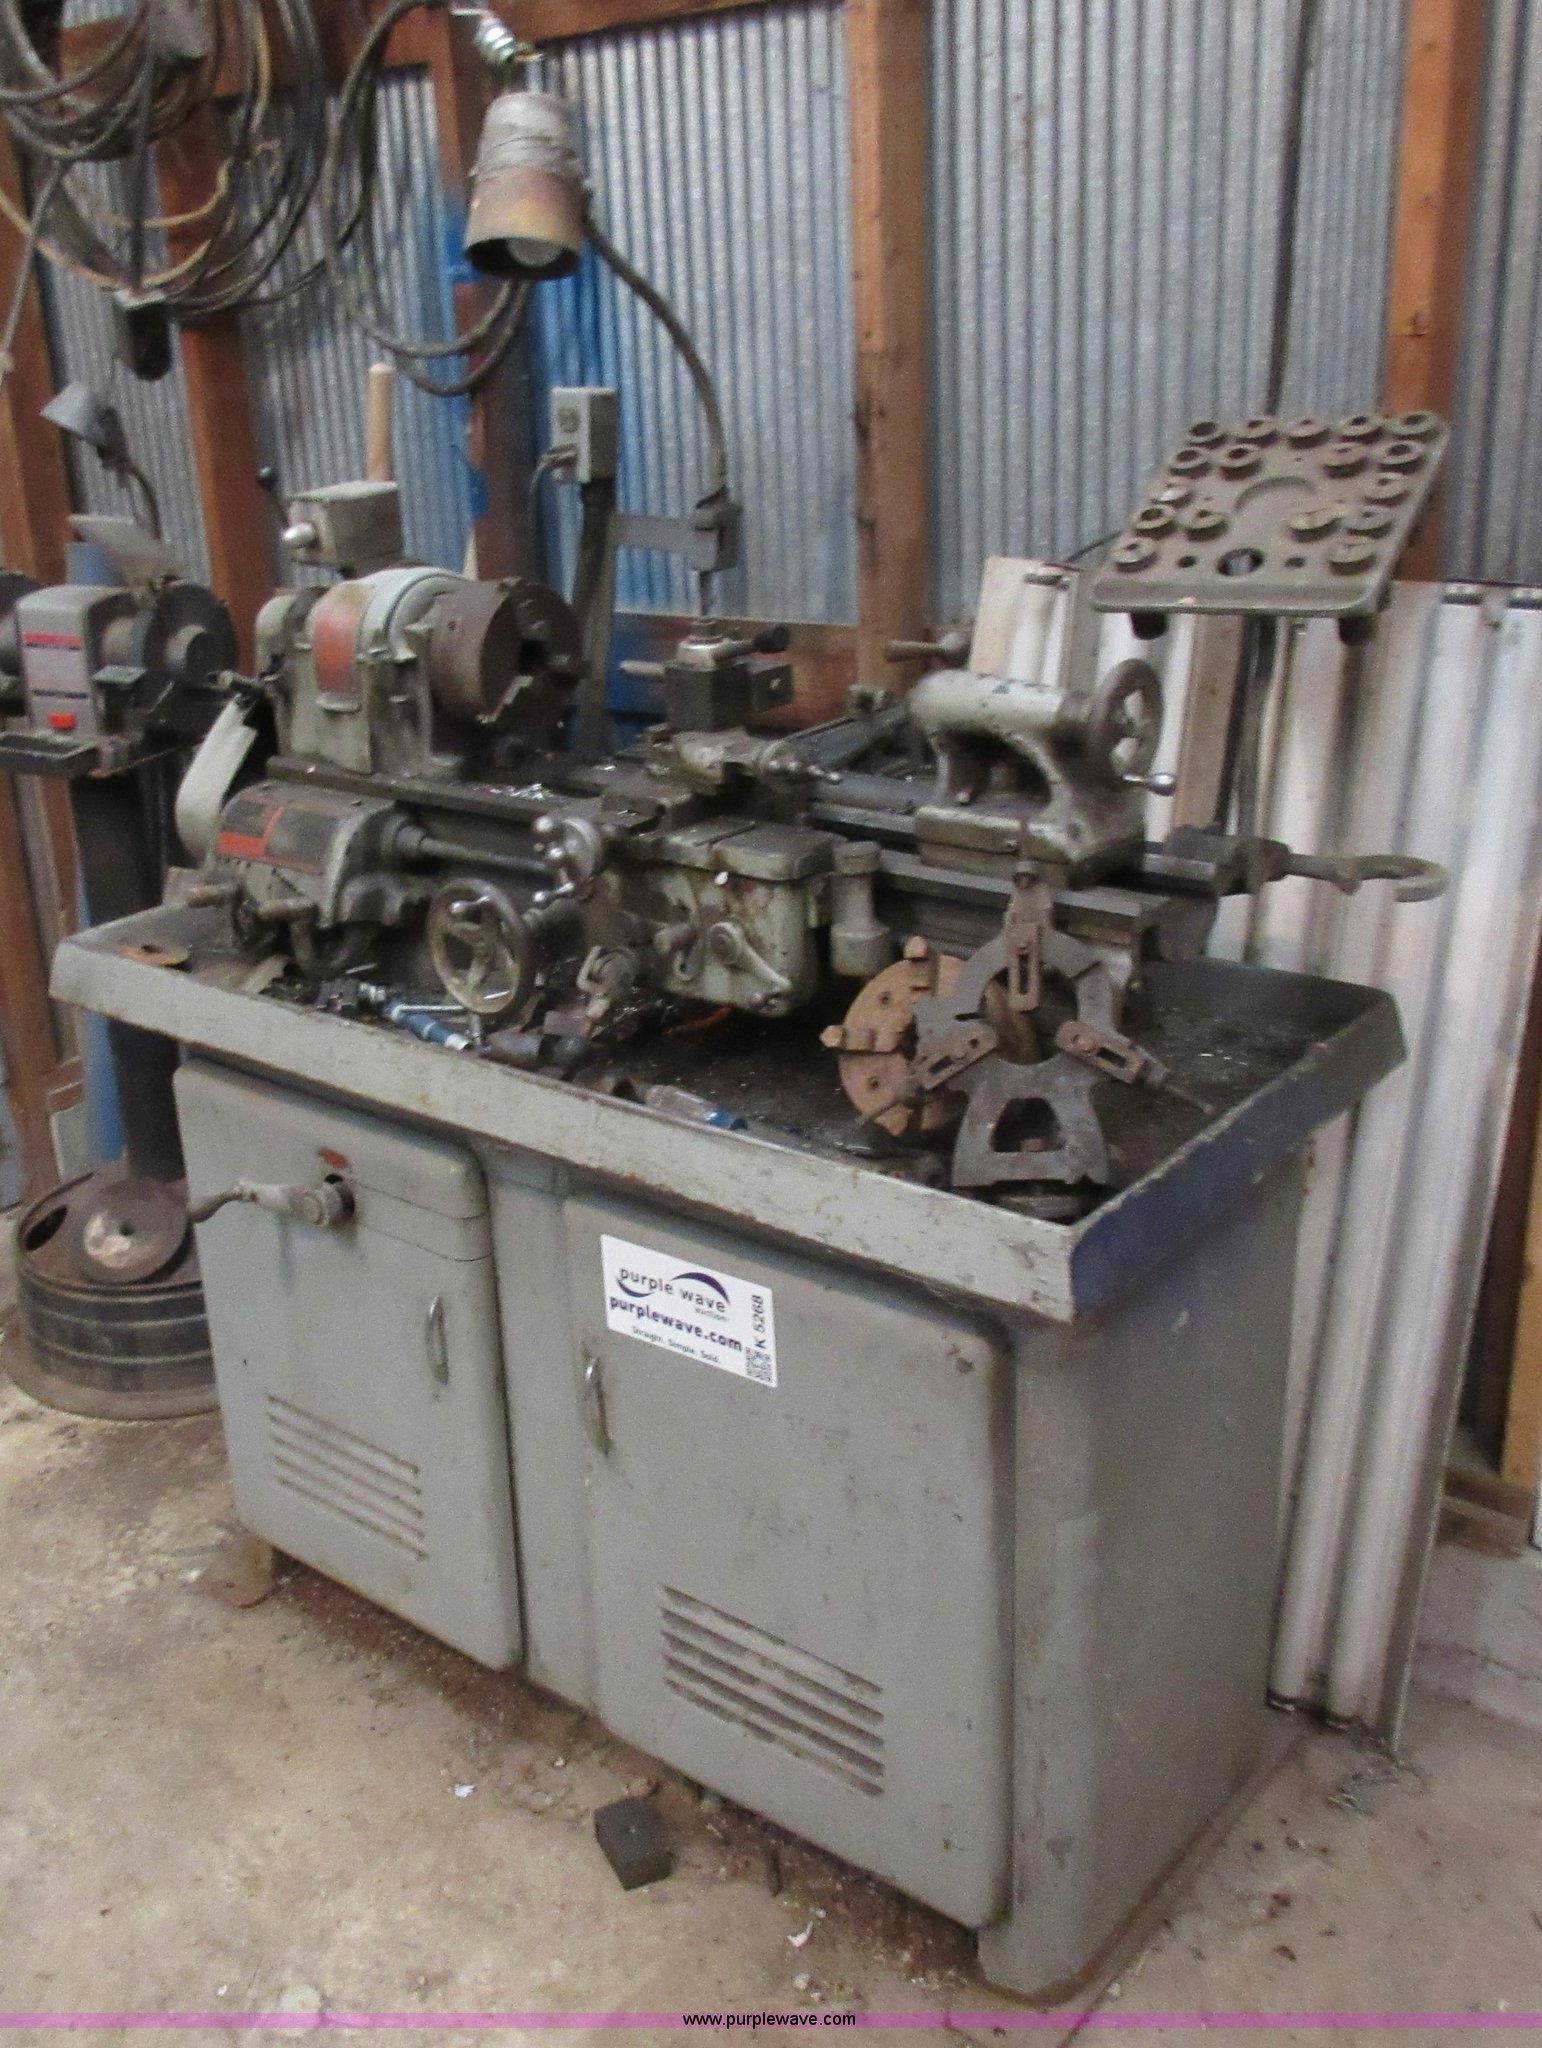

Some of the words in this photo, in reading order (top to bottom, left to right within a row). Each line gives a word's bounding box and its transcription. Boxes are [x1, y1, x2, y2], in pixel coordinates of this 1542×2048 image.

[619, 1267, 674, 1295] purple
[680, 1288, 726, 1313] wave
[609, 1296, 743, 1351] purplewave.com
[754, 1338, 767, 1350] K
